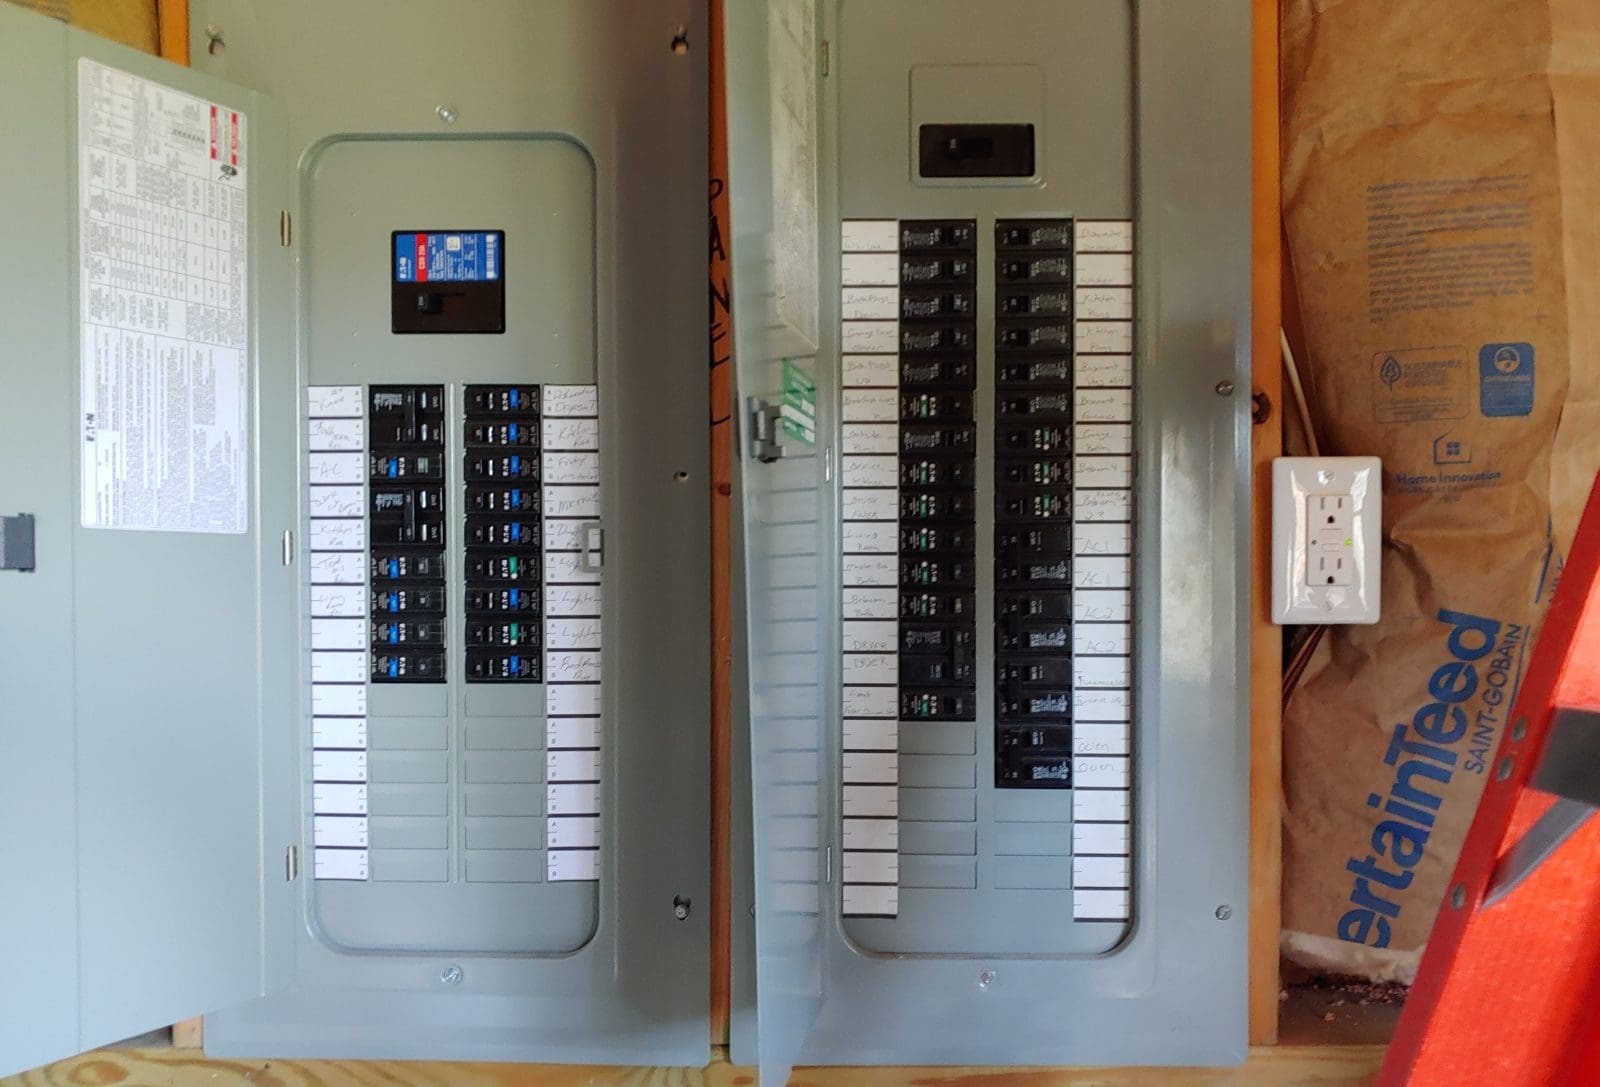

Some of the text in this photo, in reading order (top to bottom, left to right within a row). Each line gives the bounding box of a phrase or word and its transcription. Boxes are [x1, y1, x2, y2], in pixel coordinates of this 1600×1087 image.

[1396, 470, 1501, 484] Home Innovation
[853, 640, 887, 650] DRYER
[853, 657, 888, 668] DRYER
[1464, 623, 1522, 775] SAINT-GOBAIN
[1337, 608, 1501, 948] ertainTeed
